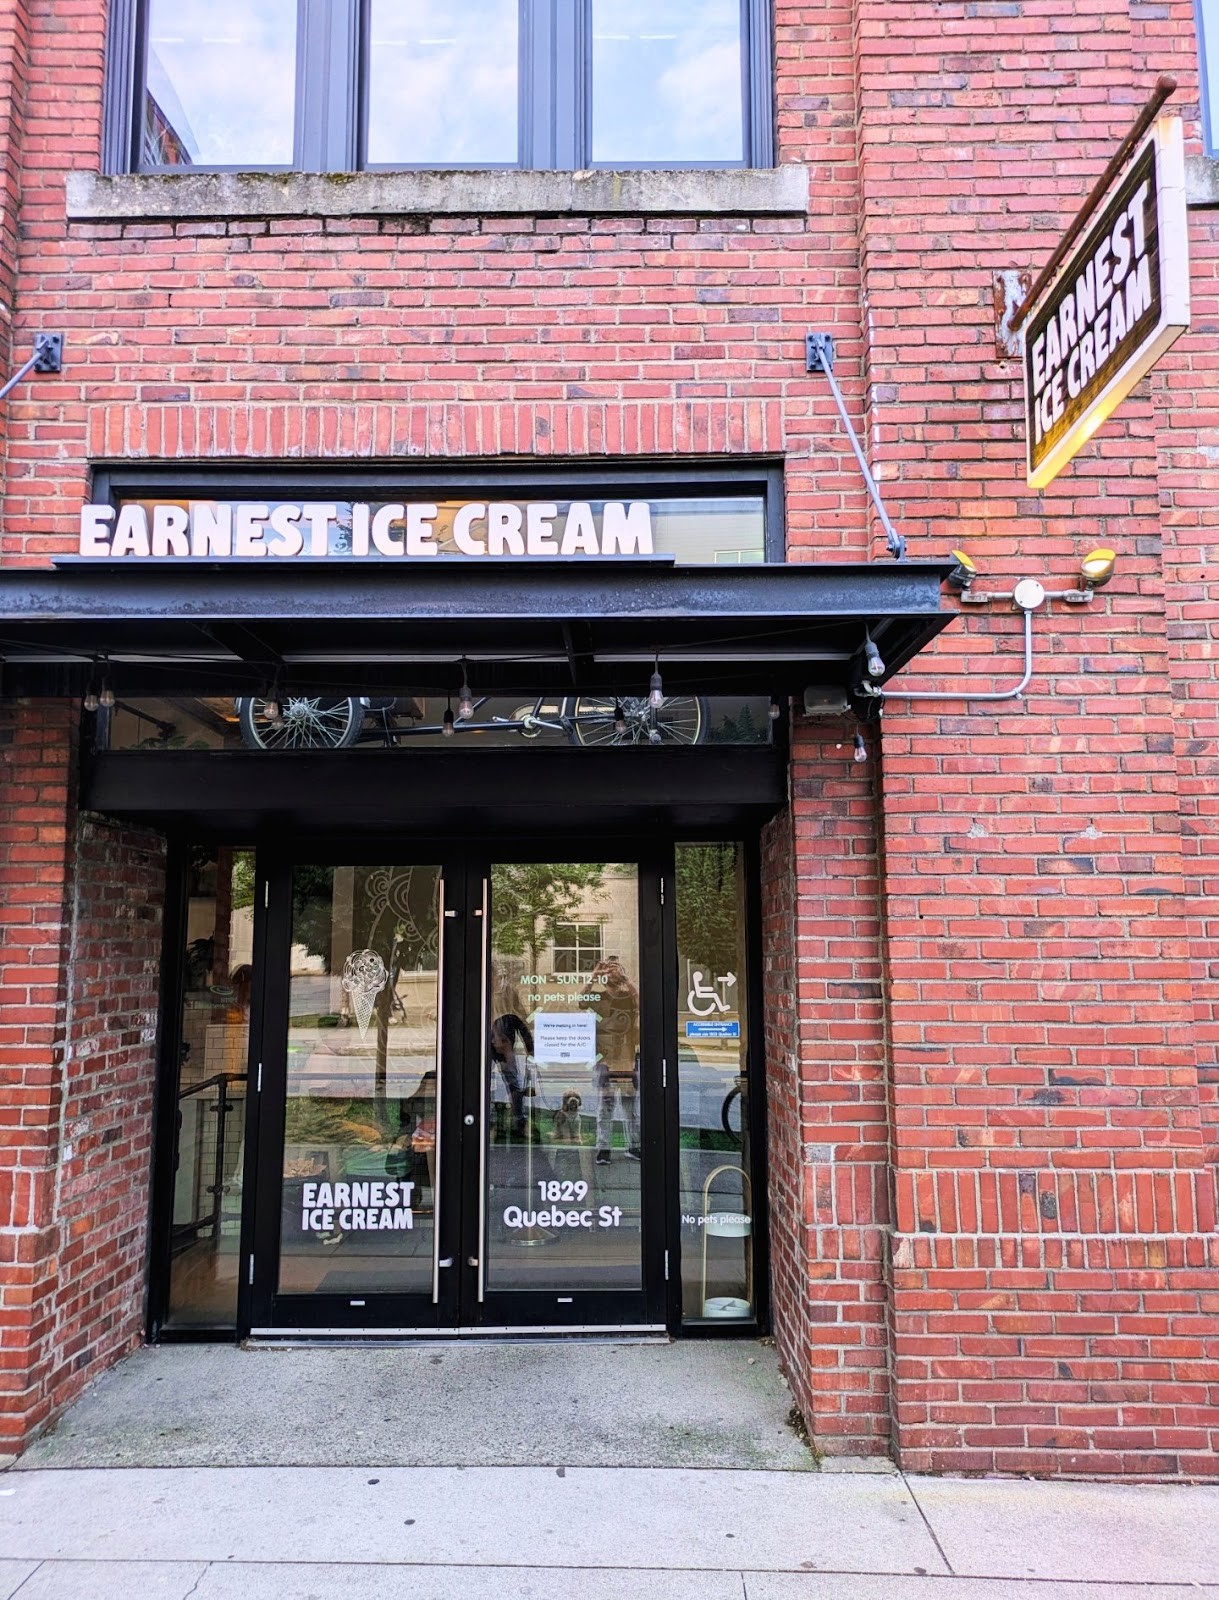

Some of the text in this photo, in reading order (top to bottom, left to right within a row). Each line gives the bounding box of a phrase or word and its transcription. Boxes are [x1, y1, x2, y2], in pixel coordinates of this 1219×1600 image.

[1031, 178, 1150, 396] EARNEST
[1033, 253, 1153, 446] ICE CREAM
[79, 502, 654, 558] EARNEST ICE CREAM
[520, 974, 546, 985] MON
[557, 974, 579, 985] SUN
[582, 974, 608, 985] 12-10
[528, 992, 601, 1004] no pets please
[302, 1181, 415, 1208] EARNEST
[538, 1180, 588, 1202] 1829
[302, 1208, 414, 1231] ICE CREAM
[503, 1205, 622, 1228] Quebec St
[681, 1214, 752, 1226] No pets please
